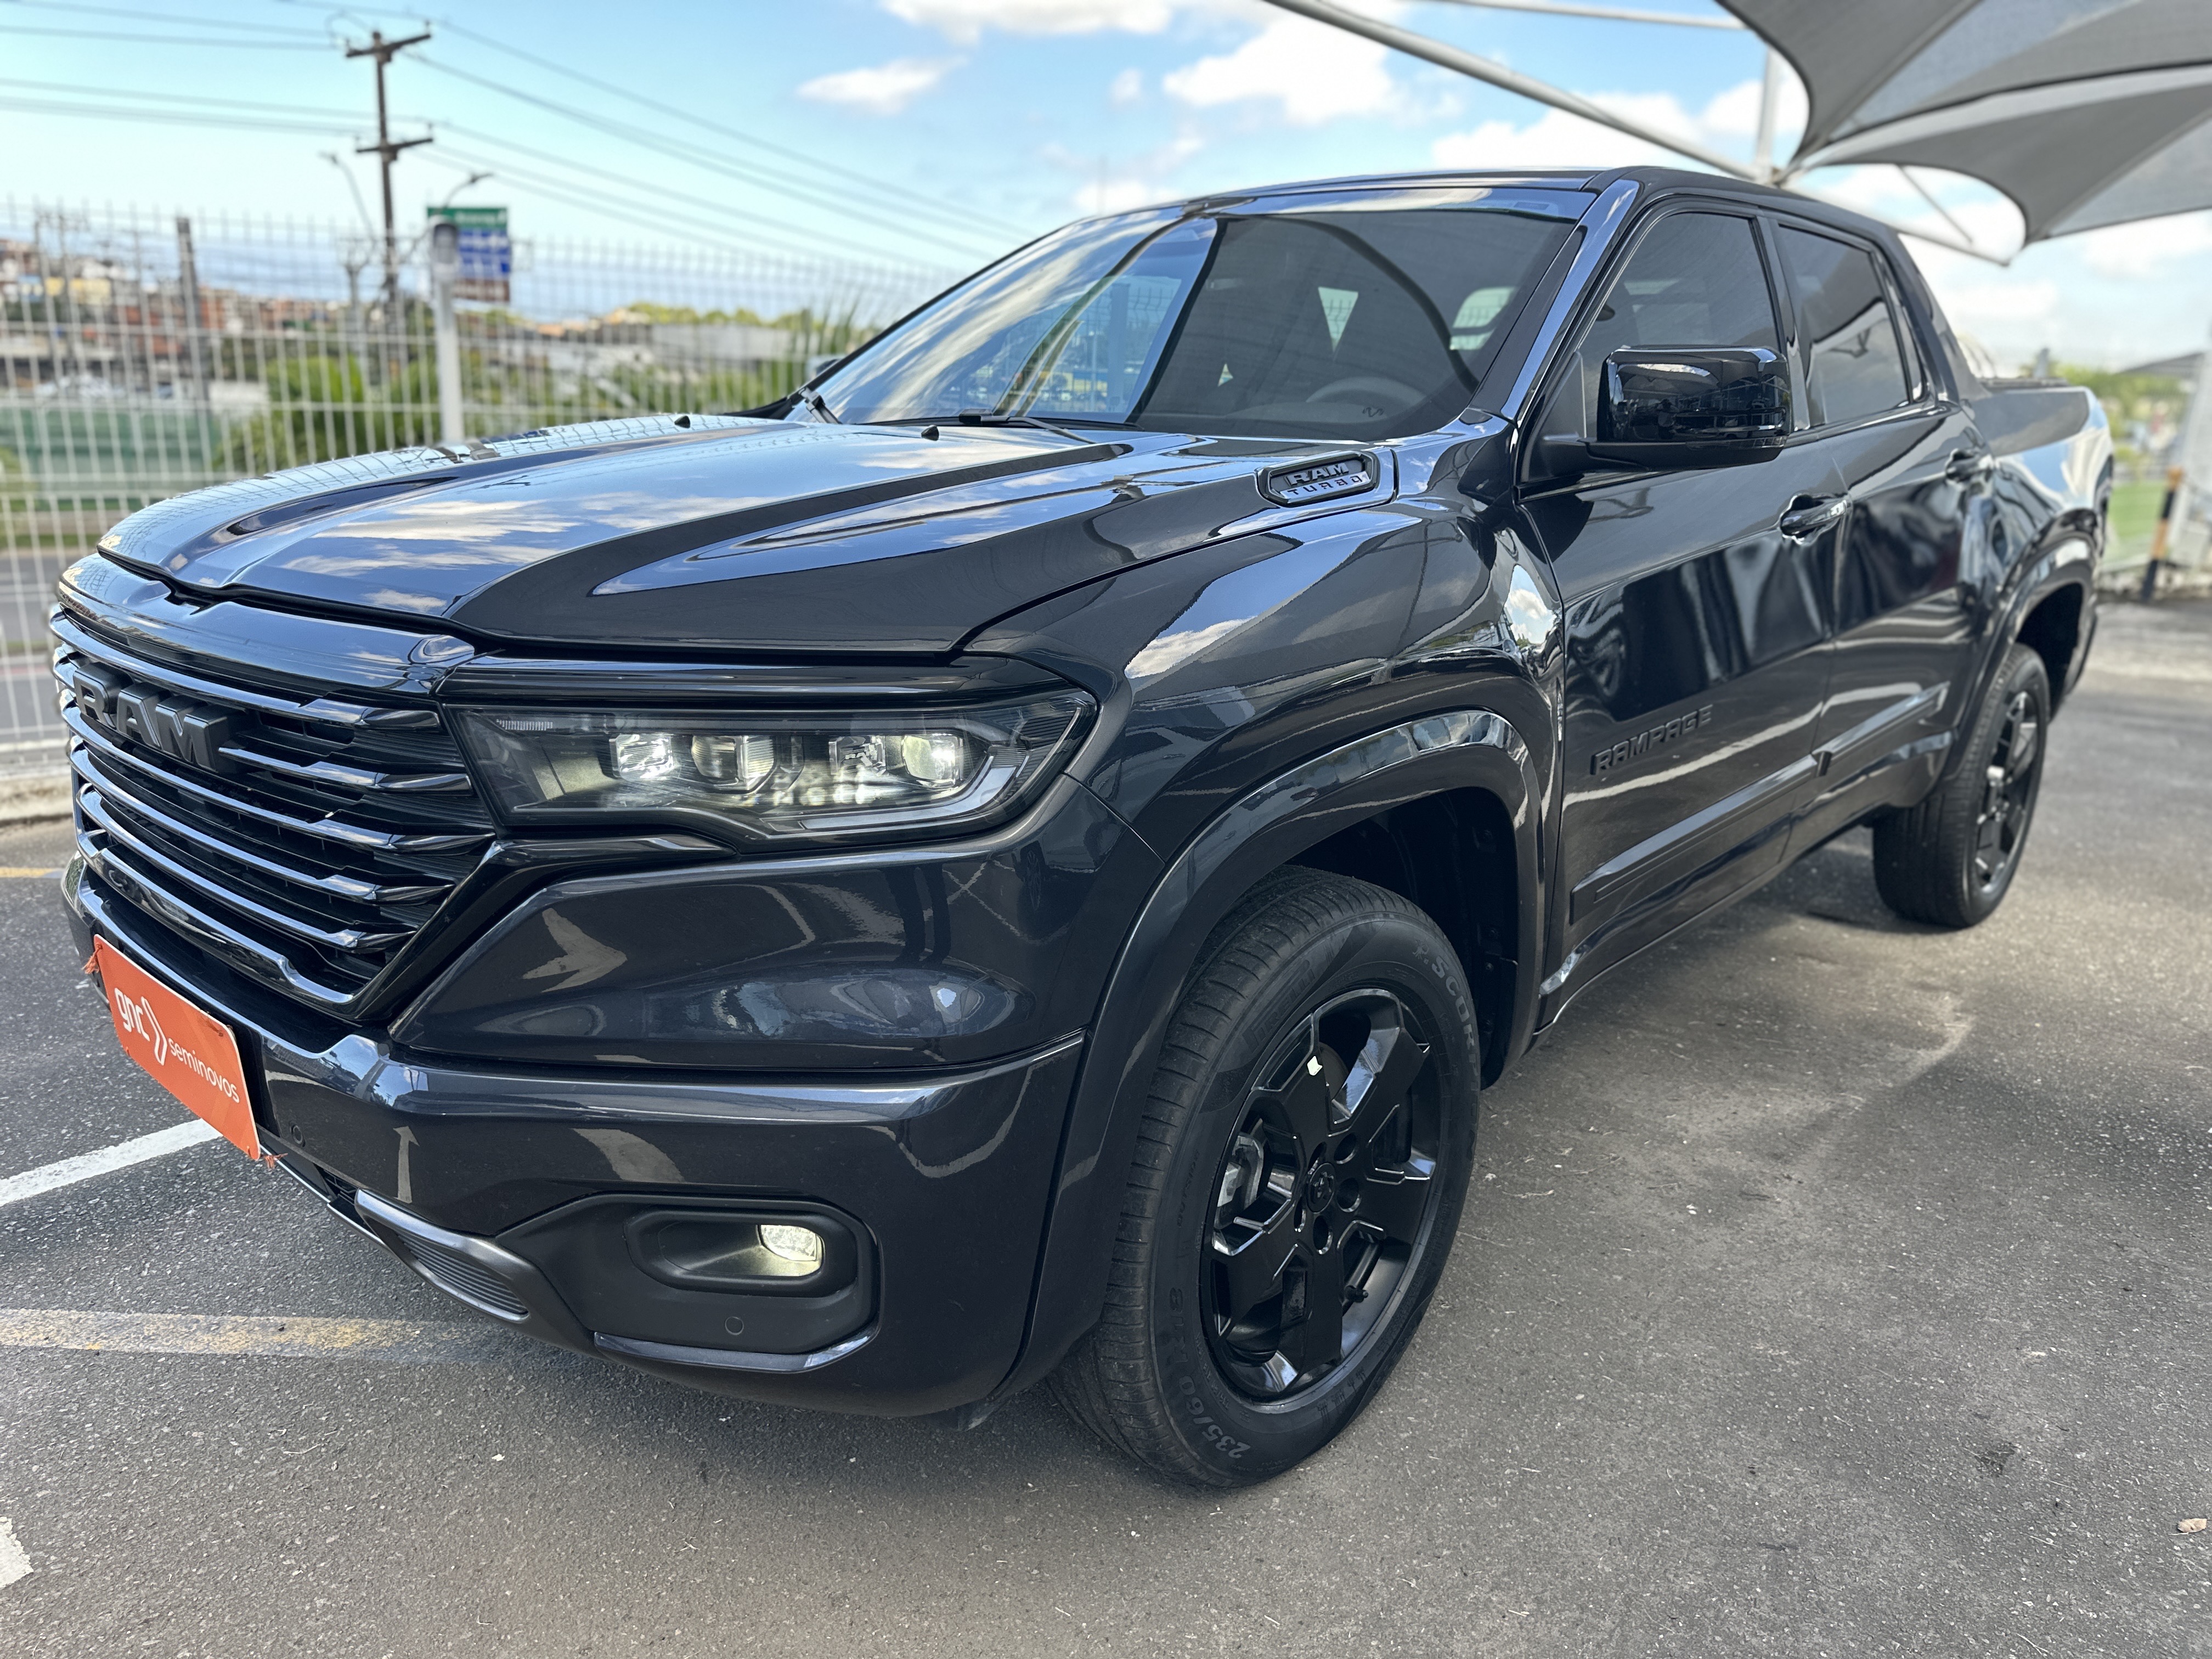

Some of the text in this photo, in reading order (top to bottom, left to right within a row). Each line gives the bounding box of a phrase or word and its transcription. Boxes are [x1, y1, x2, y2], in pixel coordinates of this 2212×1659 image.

[1284, 461, 1350, 486] RAM
[1287, 475, 1363, 495] TURBO
[72, 662, 227, 772] RAM
[1590, 704, 1713, 775] RAMPAGE
[168, 1037, 240, 1103] seminovos
